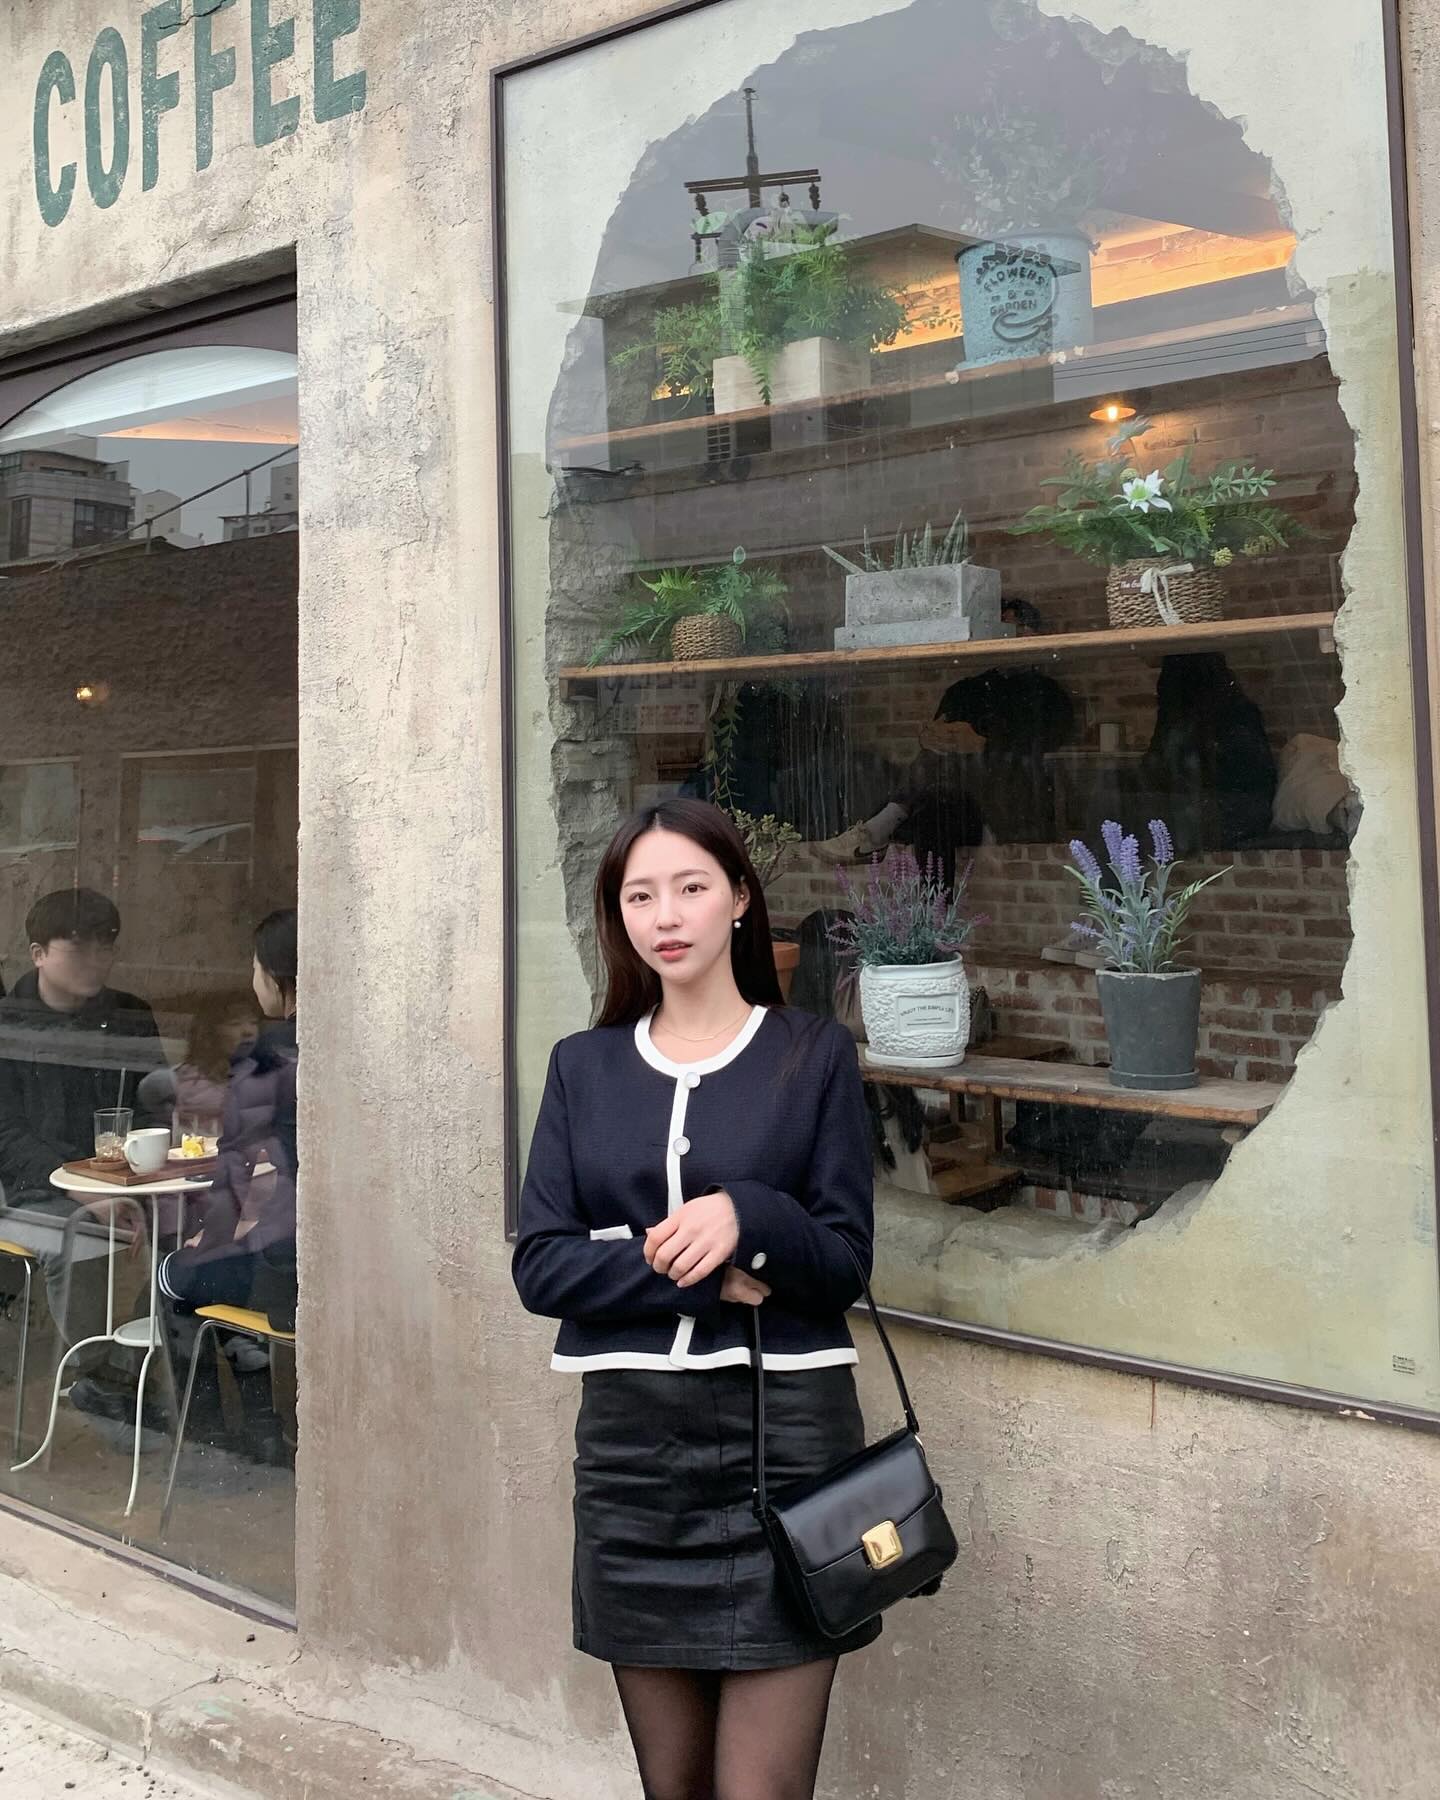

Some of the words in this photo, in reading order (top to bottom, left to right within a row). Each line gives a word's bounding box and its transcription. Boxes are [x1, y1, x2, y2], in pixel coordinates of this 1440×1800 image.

[33, 0, 367, 227] COFFEE
[984, 266, 1046, 292] FLOWERS
[990, 300, 1037, 316] GARDEN
